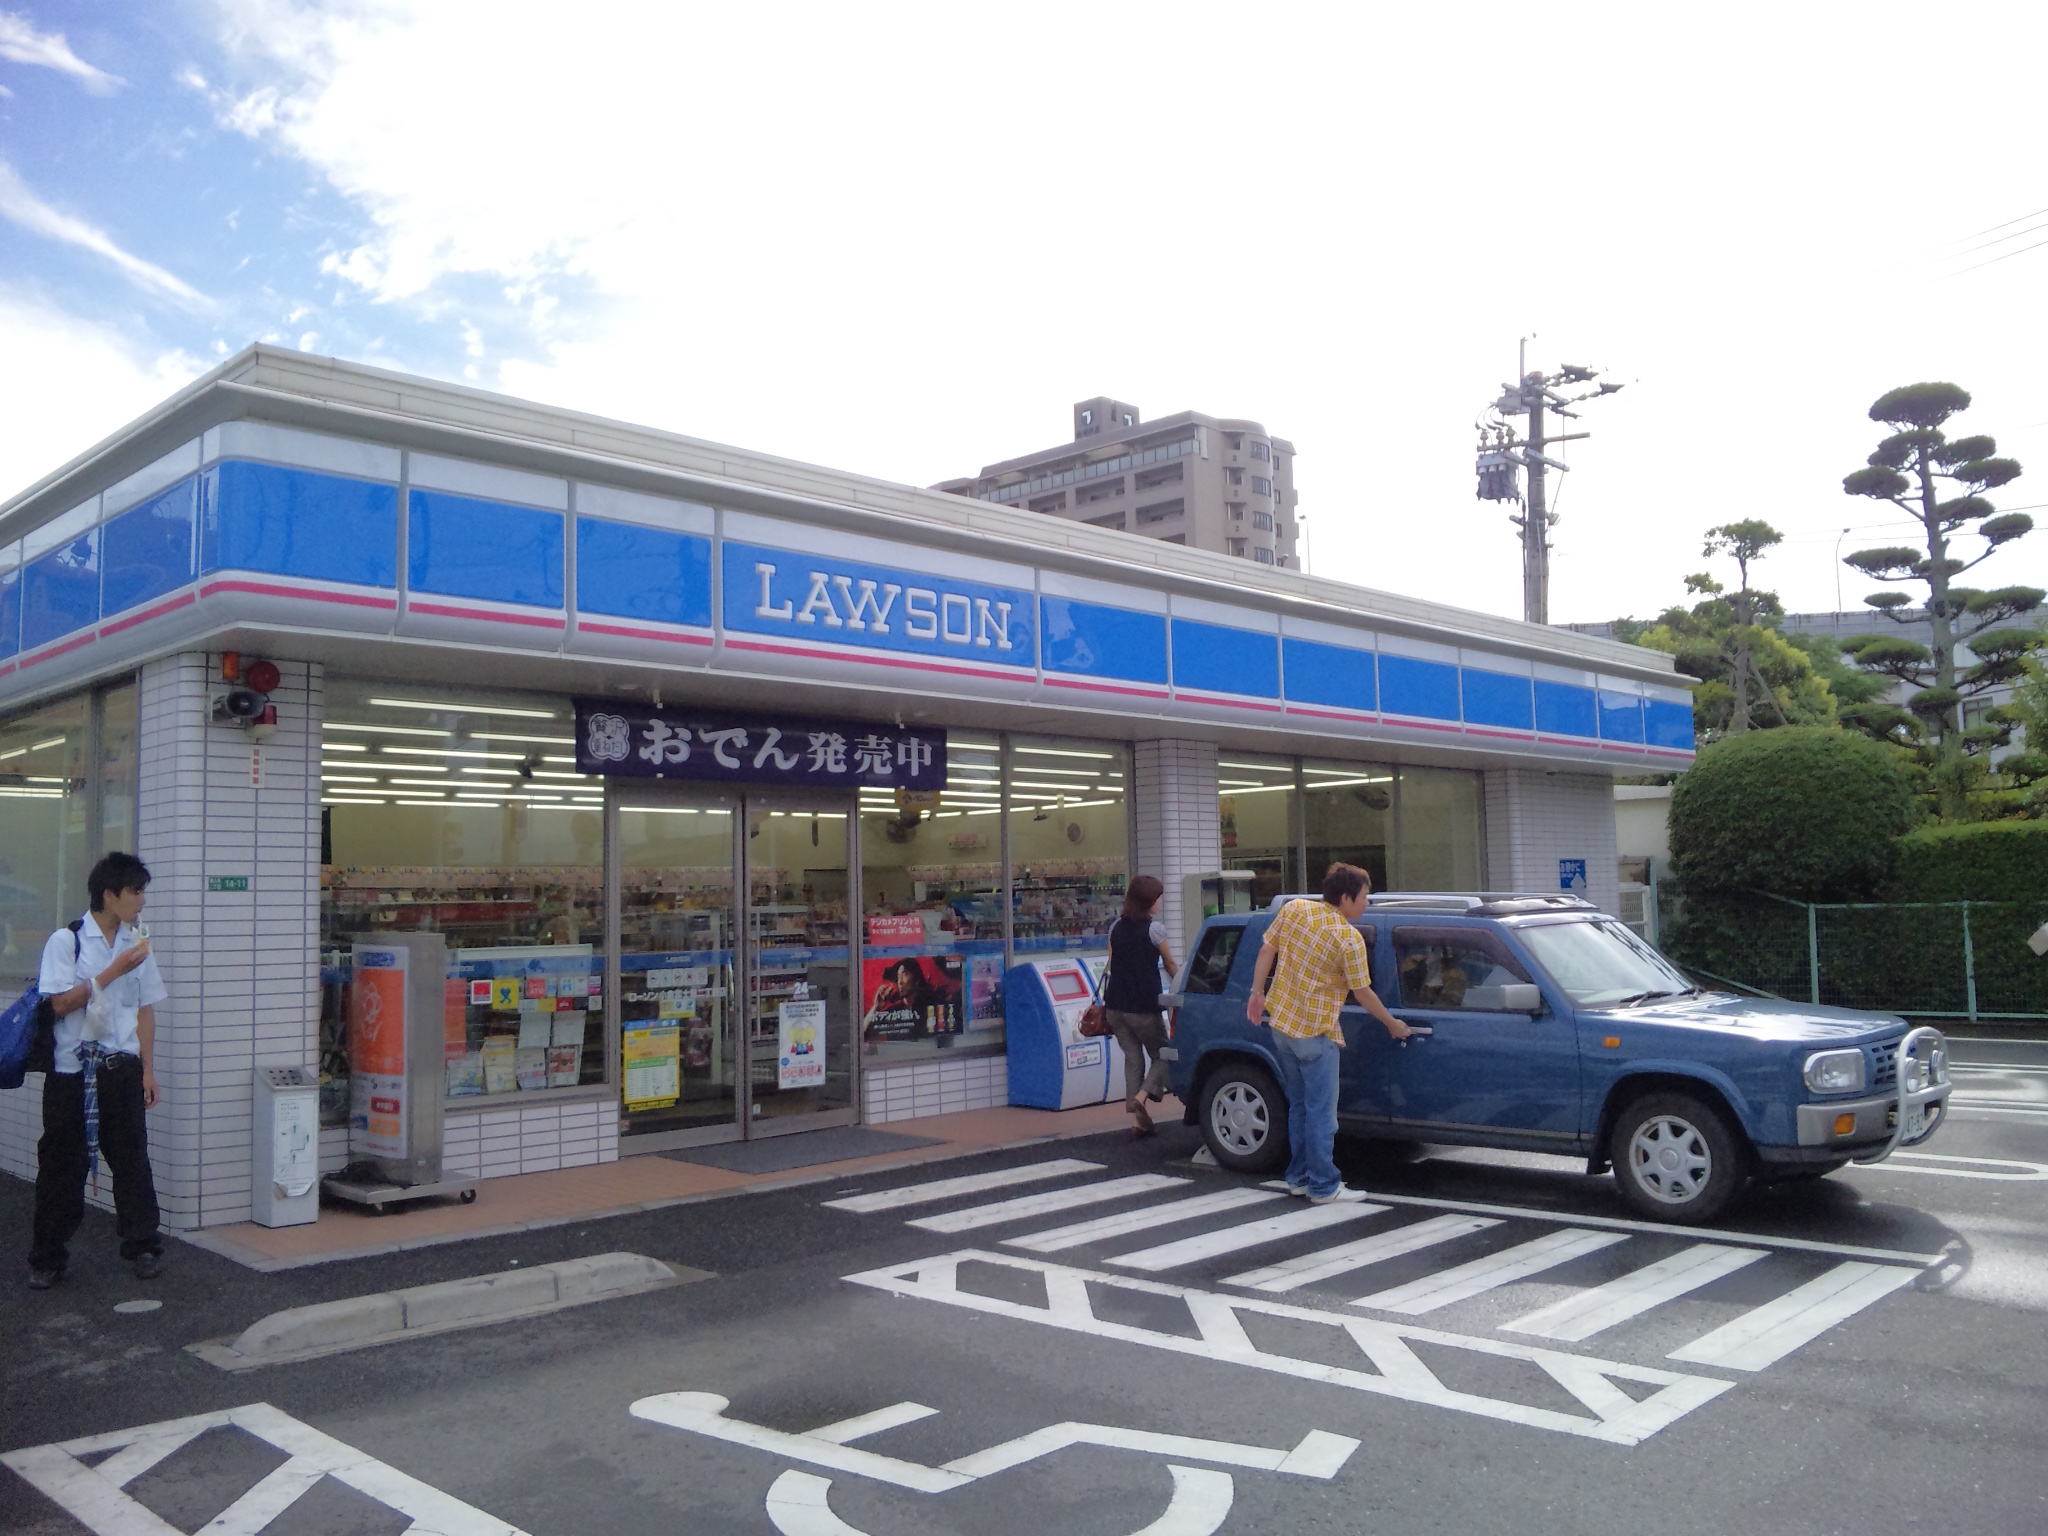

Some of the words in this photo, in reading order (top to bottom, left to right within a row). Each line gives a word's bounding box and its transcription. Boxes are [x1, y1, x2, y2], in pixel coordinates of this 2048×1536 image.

[754, 562, 1013, 651] LAWSON
[638, 718, 934, 777] おでん発売中
